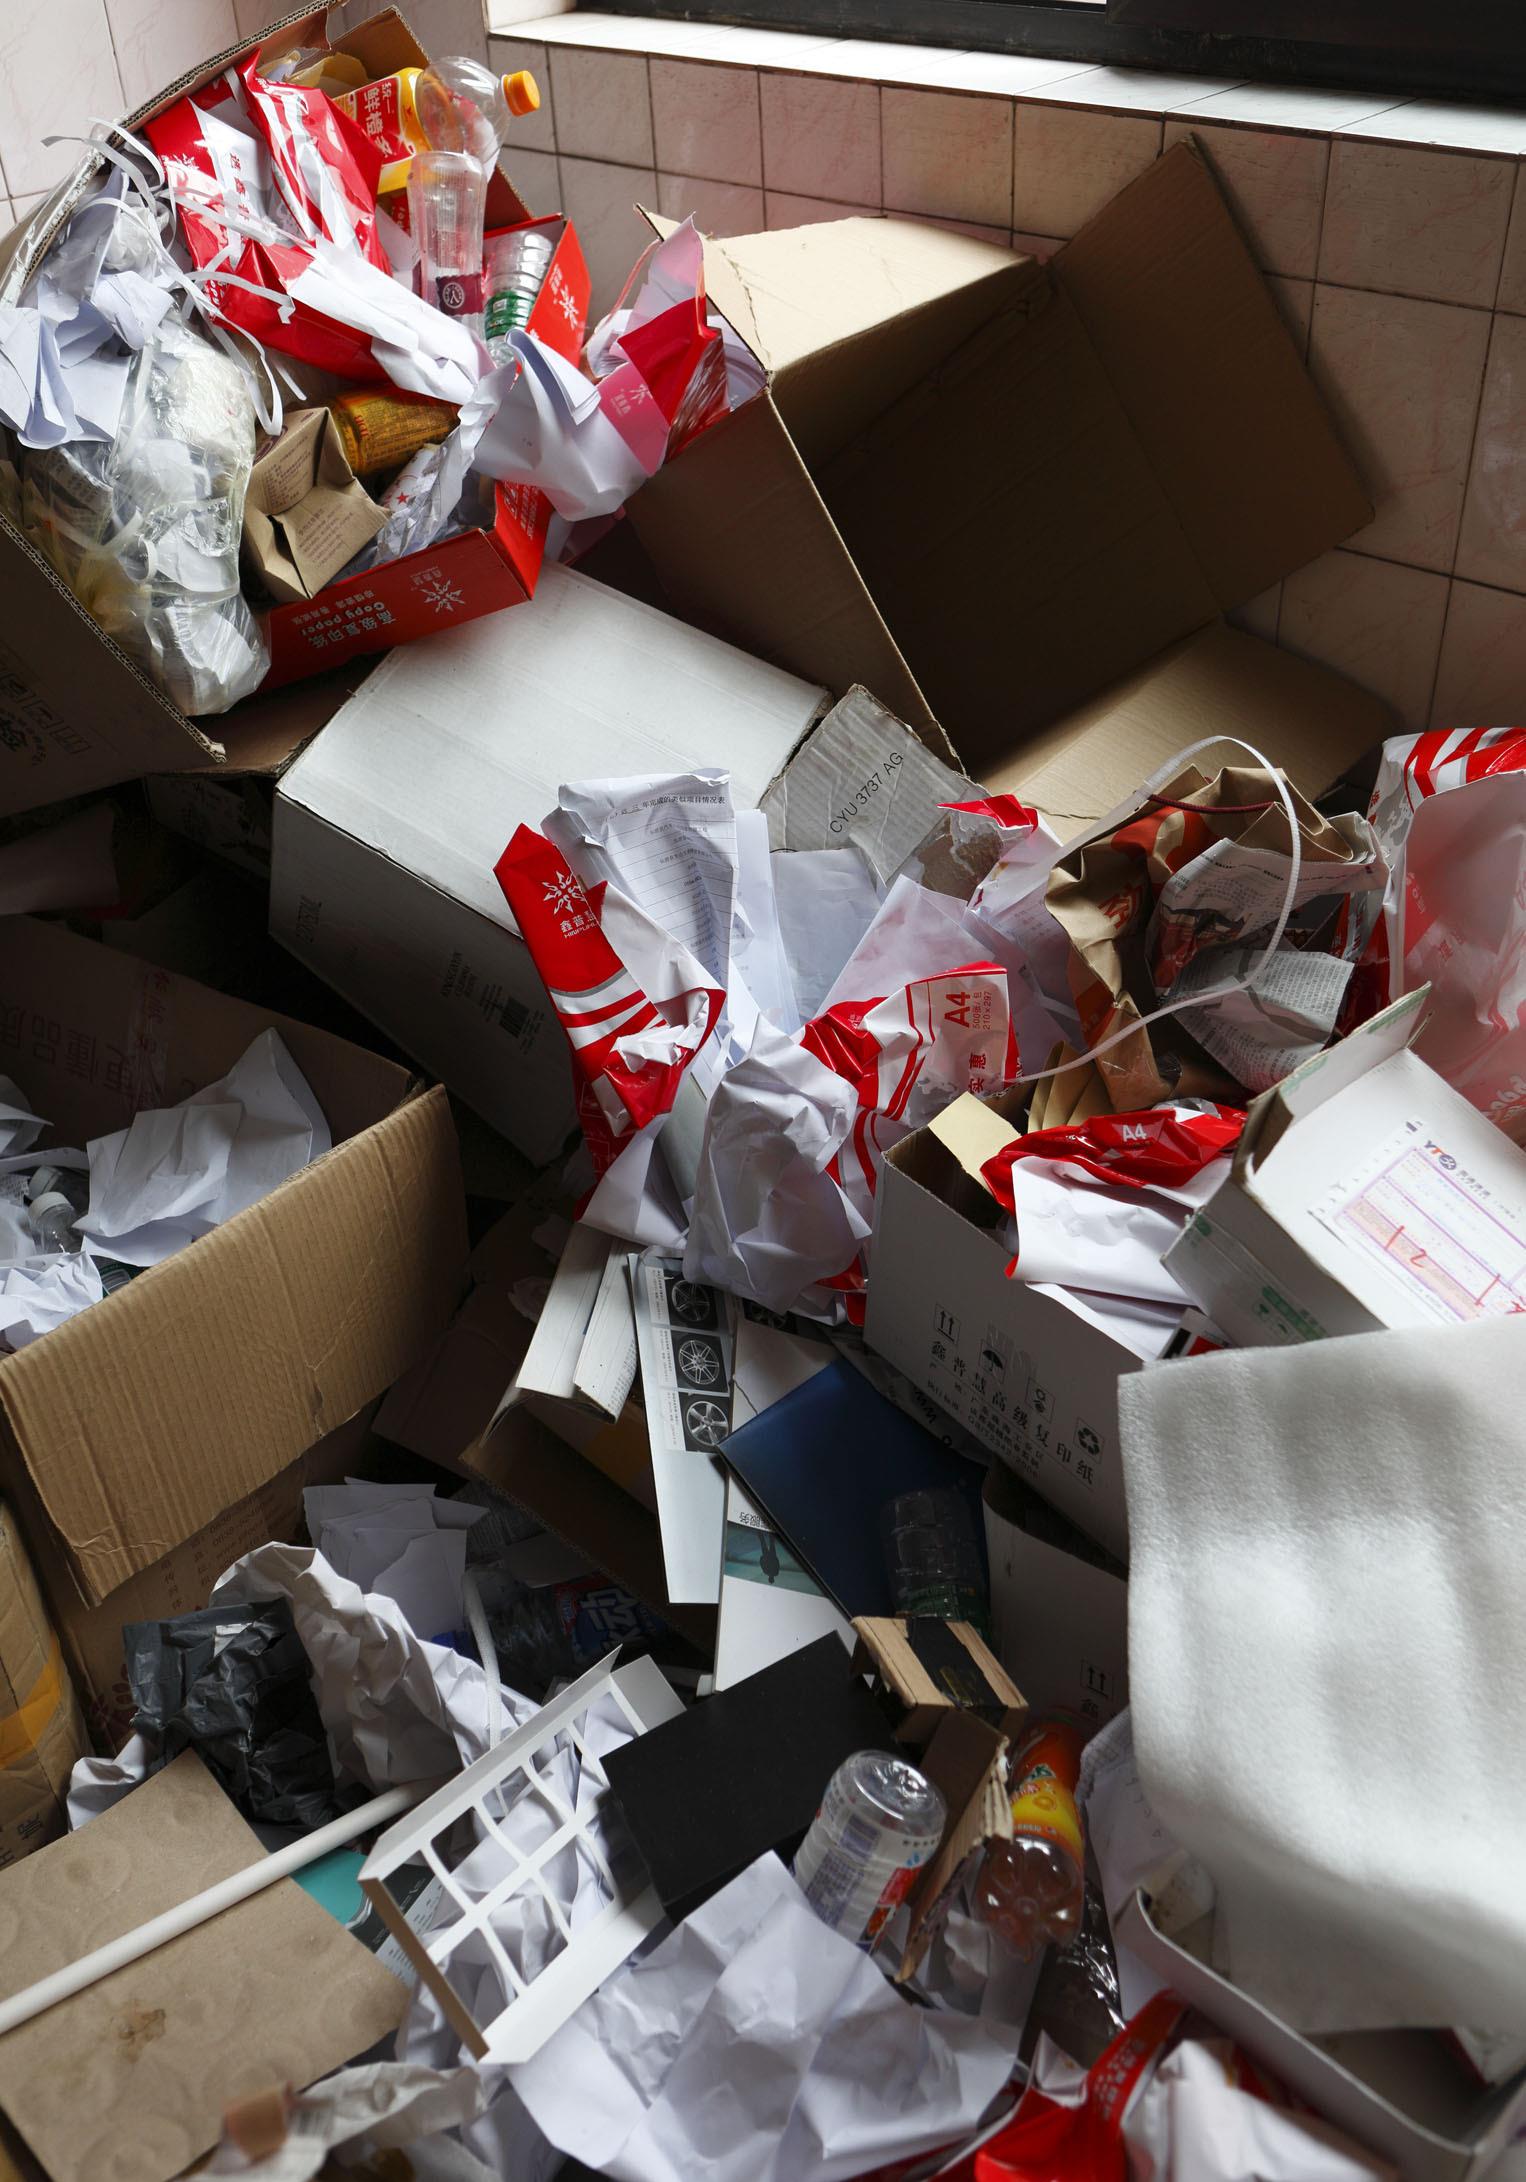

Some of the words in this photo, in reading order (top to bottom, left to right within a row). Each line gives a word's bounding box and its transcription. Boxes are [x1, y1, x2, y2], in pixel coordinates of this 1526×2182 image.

[344, 601, 385, 619] Copy
[829, 800, 859, 835] CYU
[854, 773, 887, 808] 3737
[882, 751, 904, 777] AG
[944, 991, 971, 1029] A4
[1121, 1122, 1148, 1143] A4
